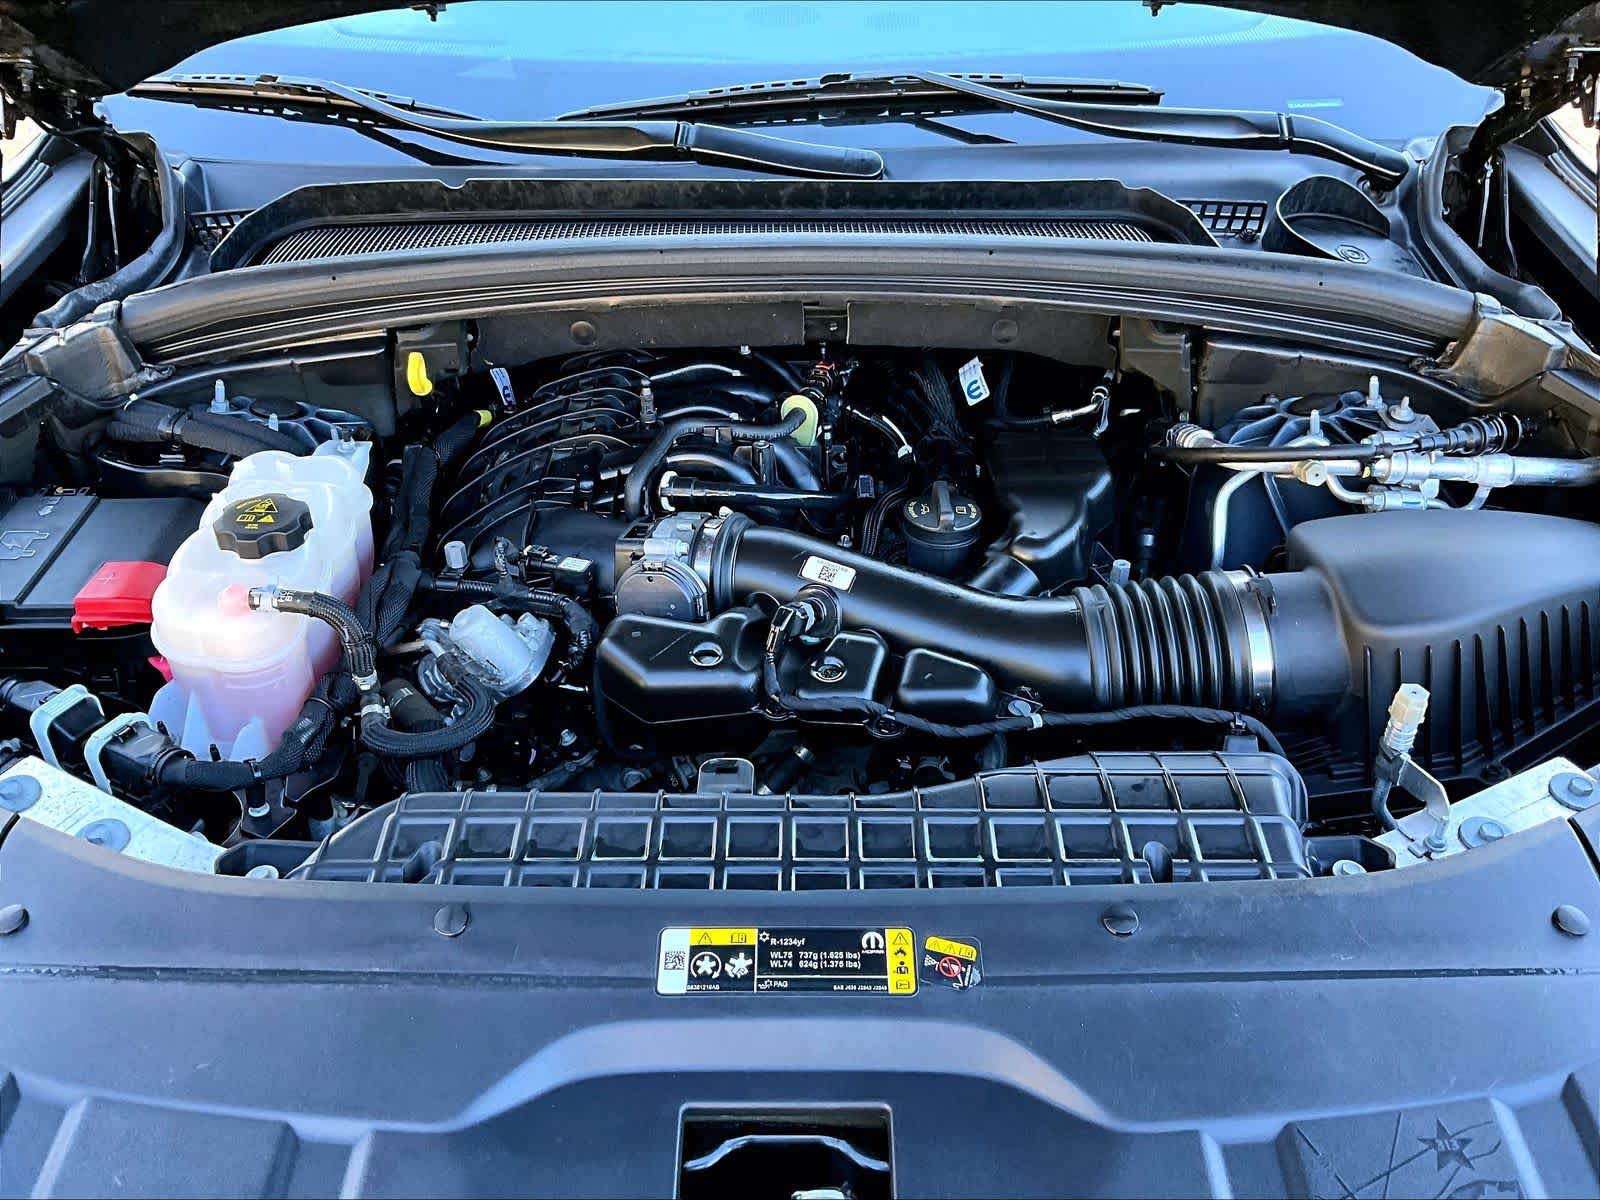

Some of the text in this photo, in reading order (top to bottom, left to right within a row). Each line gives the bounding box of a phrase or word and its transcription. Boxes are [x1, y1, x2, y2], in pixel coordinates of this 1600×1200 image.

[770, 938, 805, 947] R-1234yf
[770, 951, 861, 960] WL75 737g (1.625 lbs)
[770, 960, 861, 969] WL74 624g (1.375 lbs)
